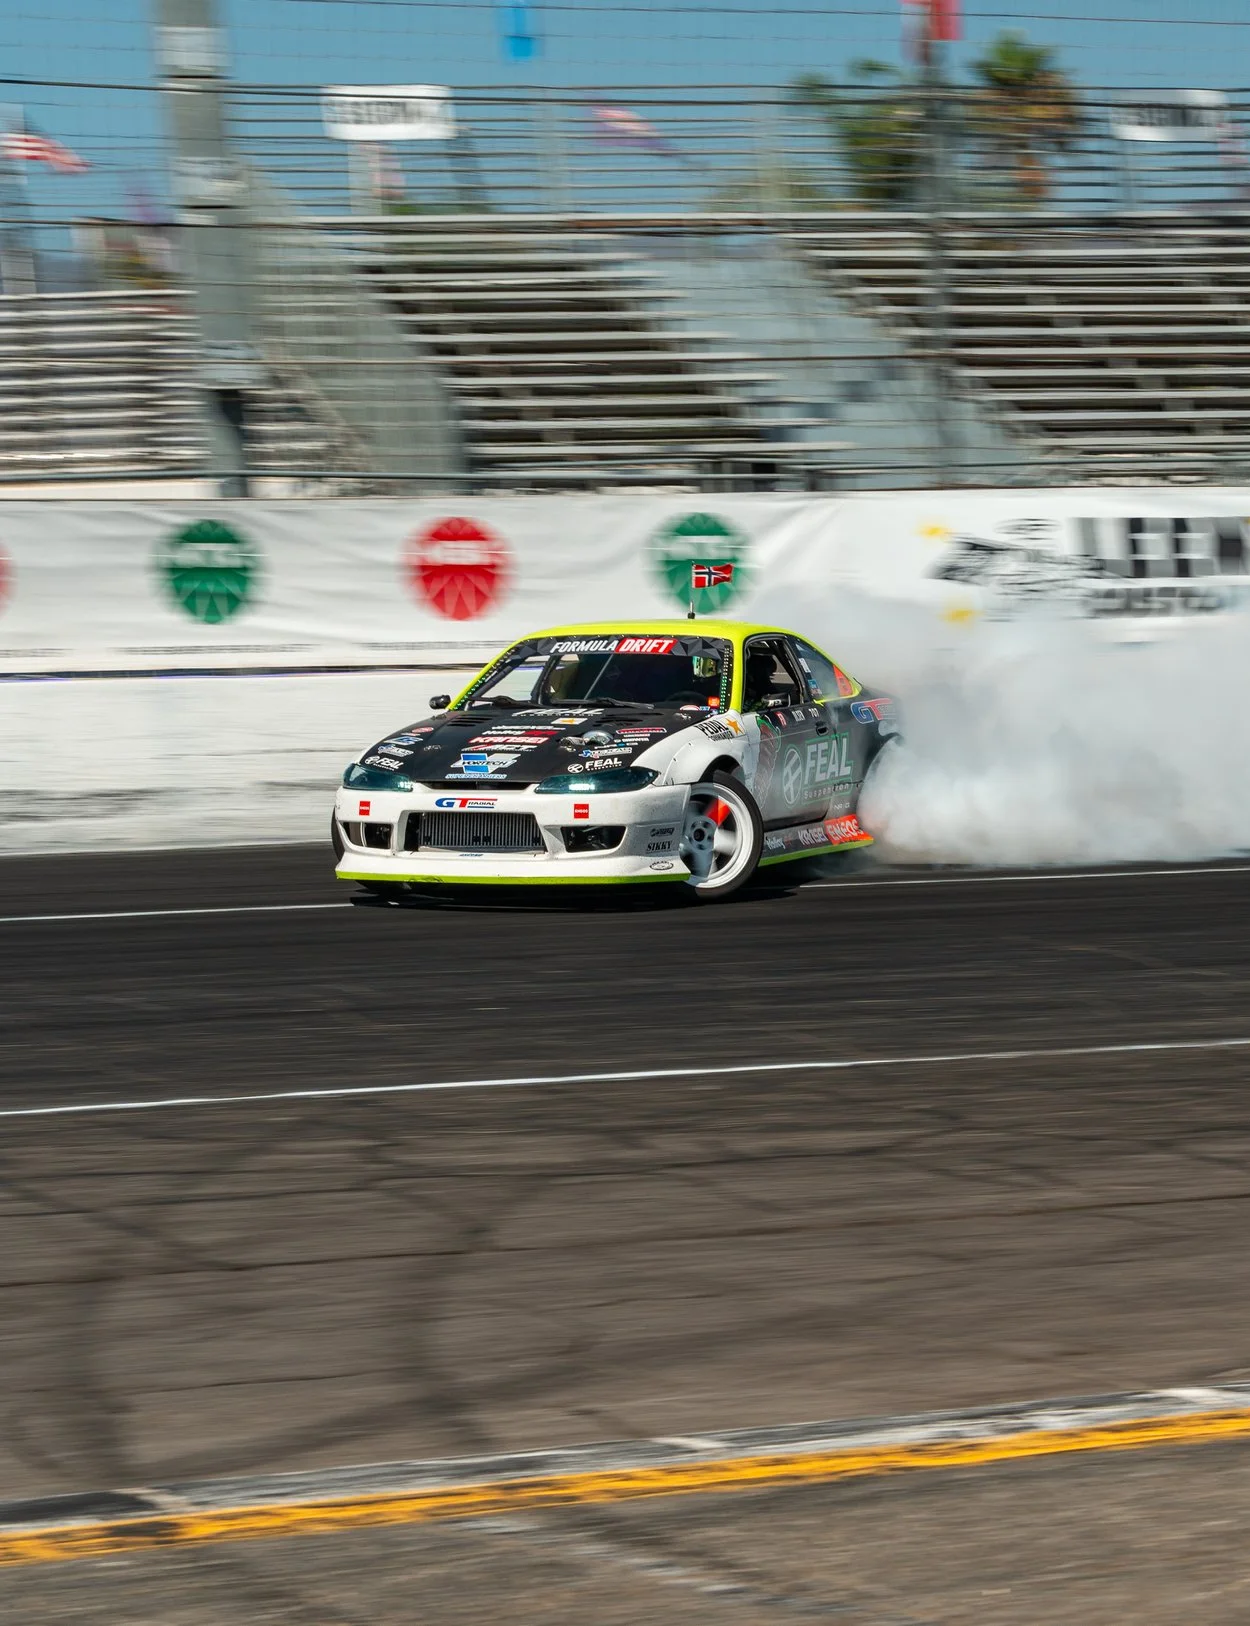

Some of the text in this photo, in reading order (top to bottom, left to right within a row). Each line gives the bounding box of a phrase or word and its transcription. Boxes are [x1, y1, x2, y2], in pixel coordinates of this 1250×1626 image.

[549, 638, 674, 653] FORMULA DRIFT
[694, 719, 729, 736] PEDAL
[376, 757, 404, 770] FEAL
[585, 757, 622, 769] FEAL
[804, 737, 852, 784] FEAL
[435, 798, 482, 808] GT
[827, 818, 865, 840] ENEOS
[646, 840, 673, 851] SIKKY
